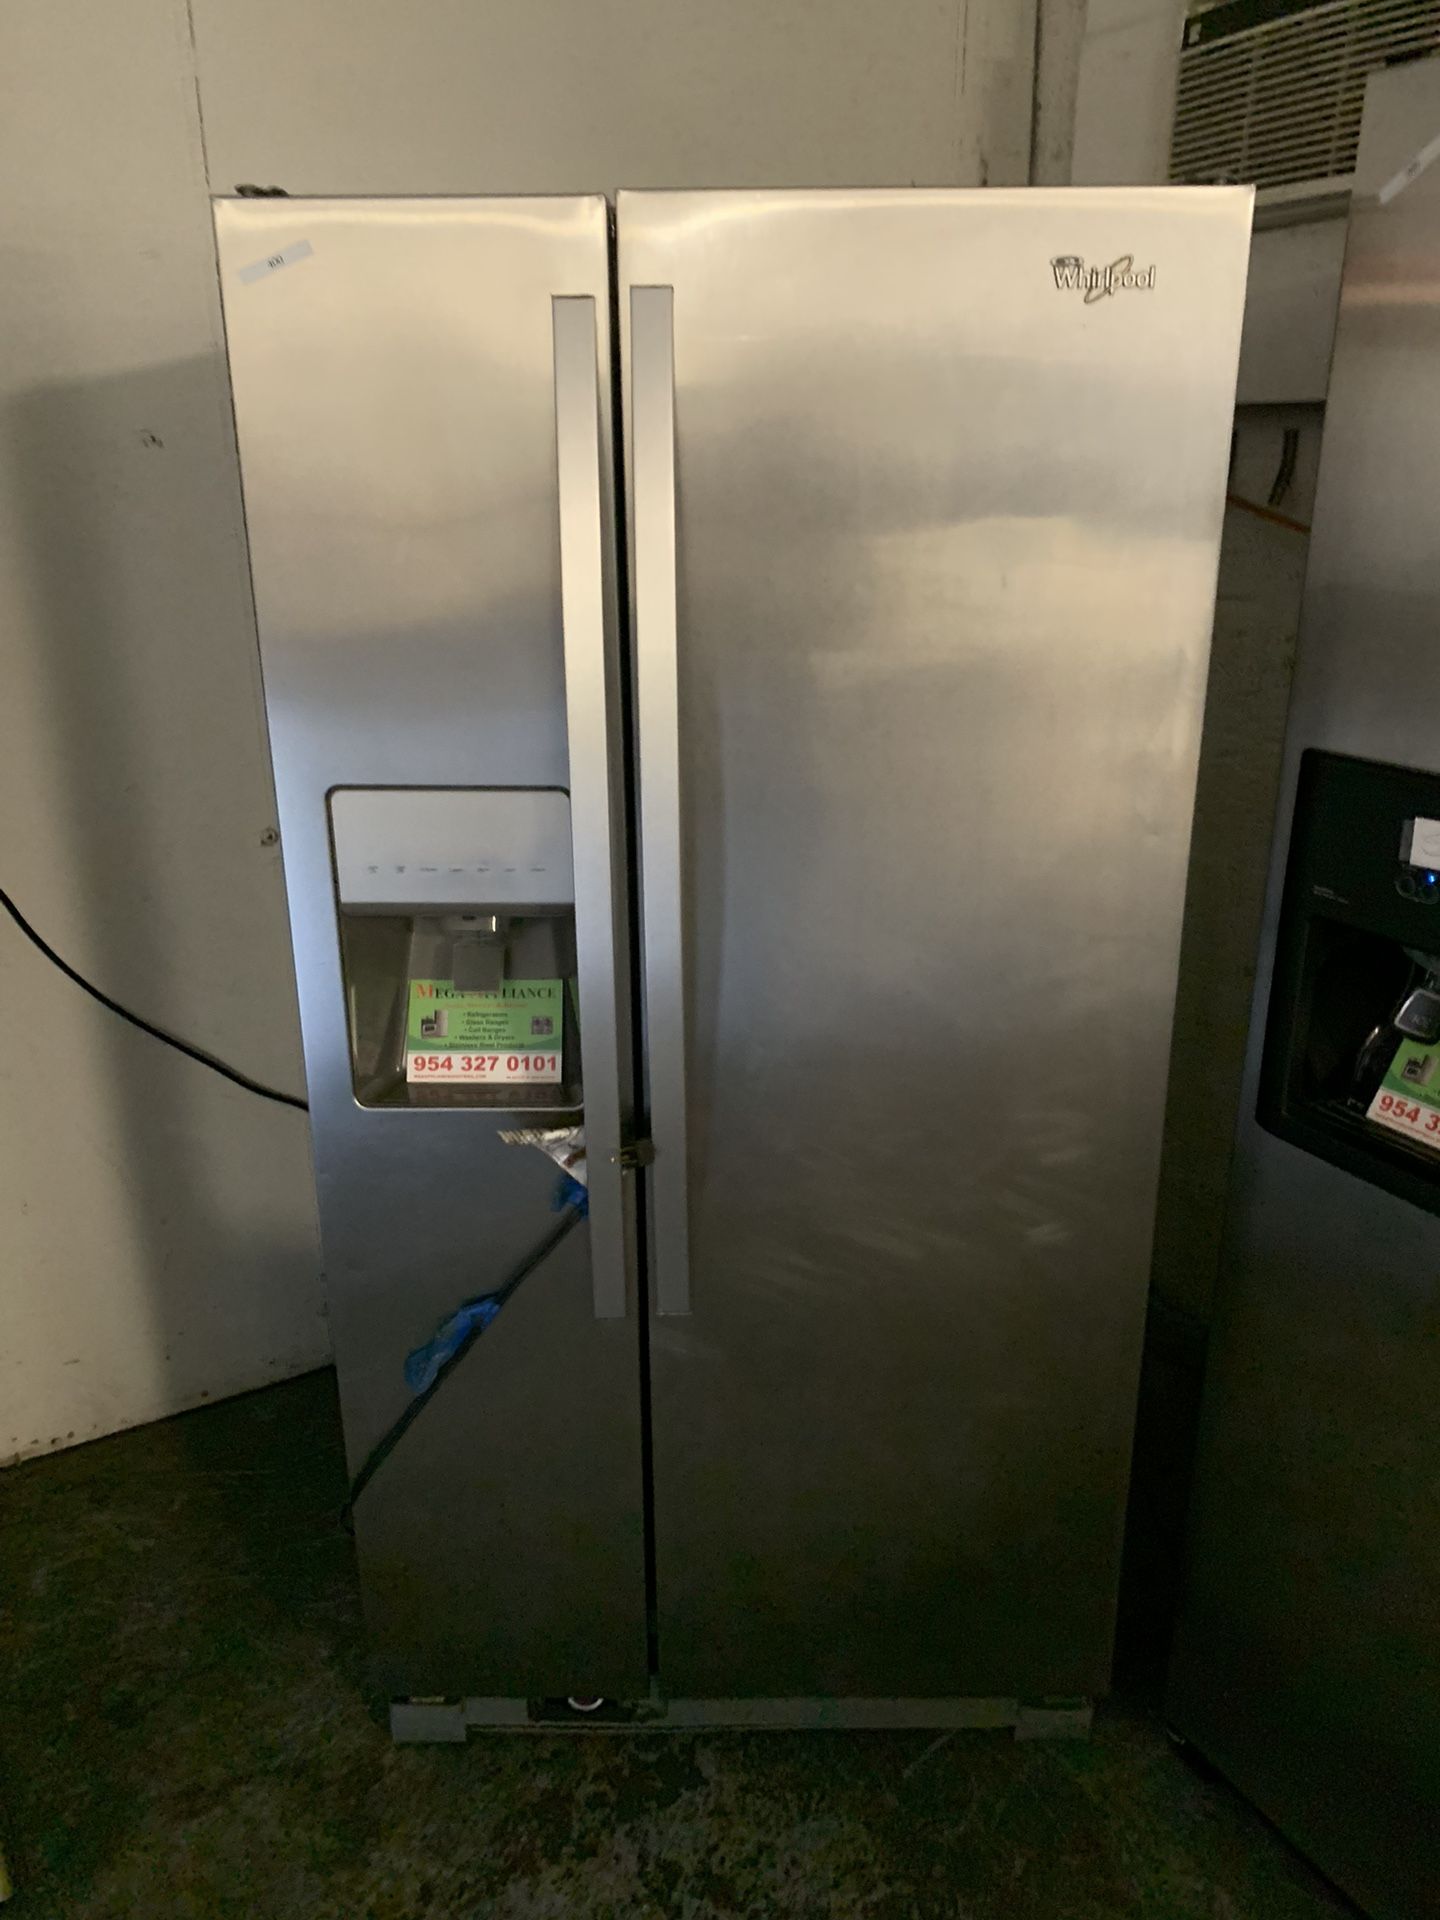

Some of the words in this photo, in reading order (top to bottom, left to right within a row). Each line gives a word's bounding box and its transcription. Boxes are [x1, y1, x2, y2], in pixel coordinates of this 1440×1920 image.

[1050, 255, 1156, 303] Whirlpool
[413, 1055, 453, 1072] 954
[461, 1055, 499, 1072] 327
[506, 1055, 556, 1072] 0101
[1379, 1095, 1421, 1123] 954
